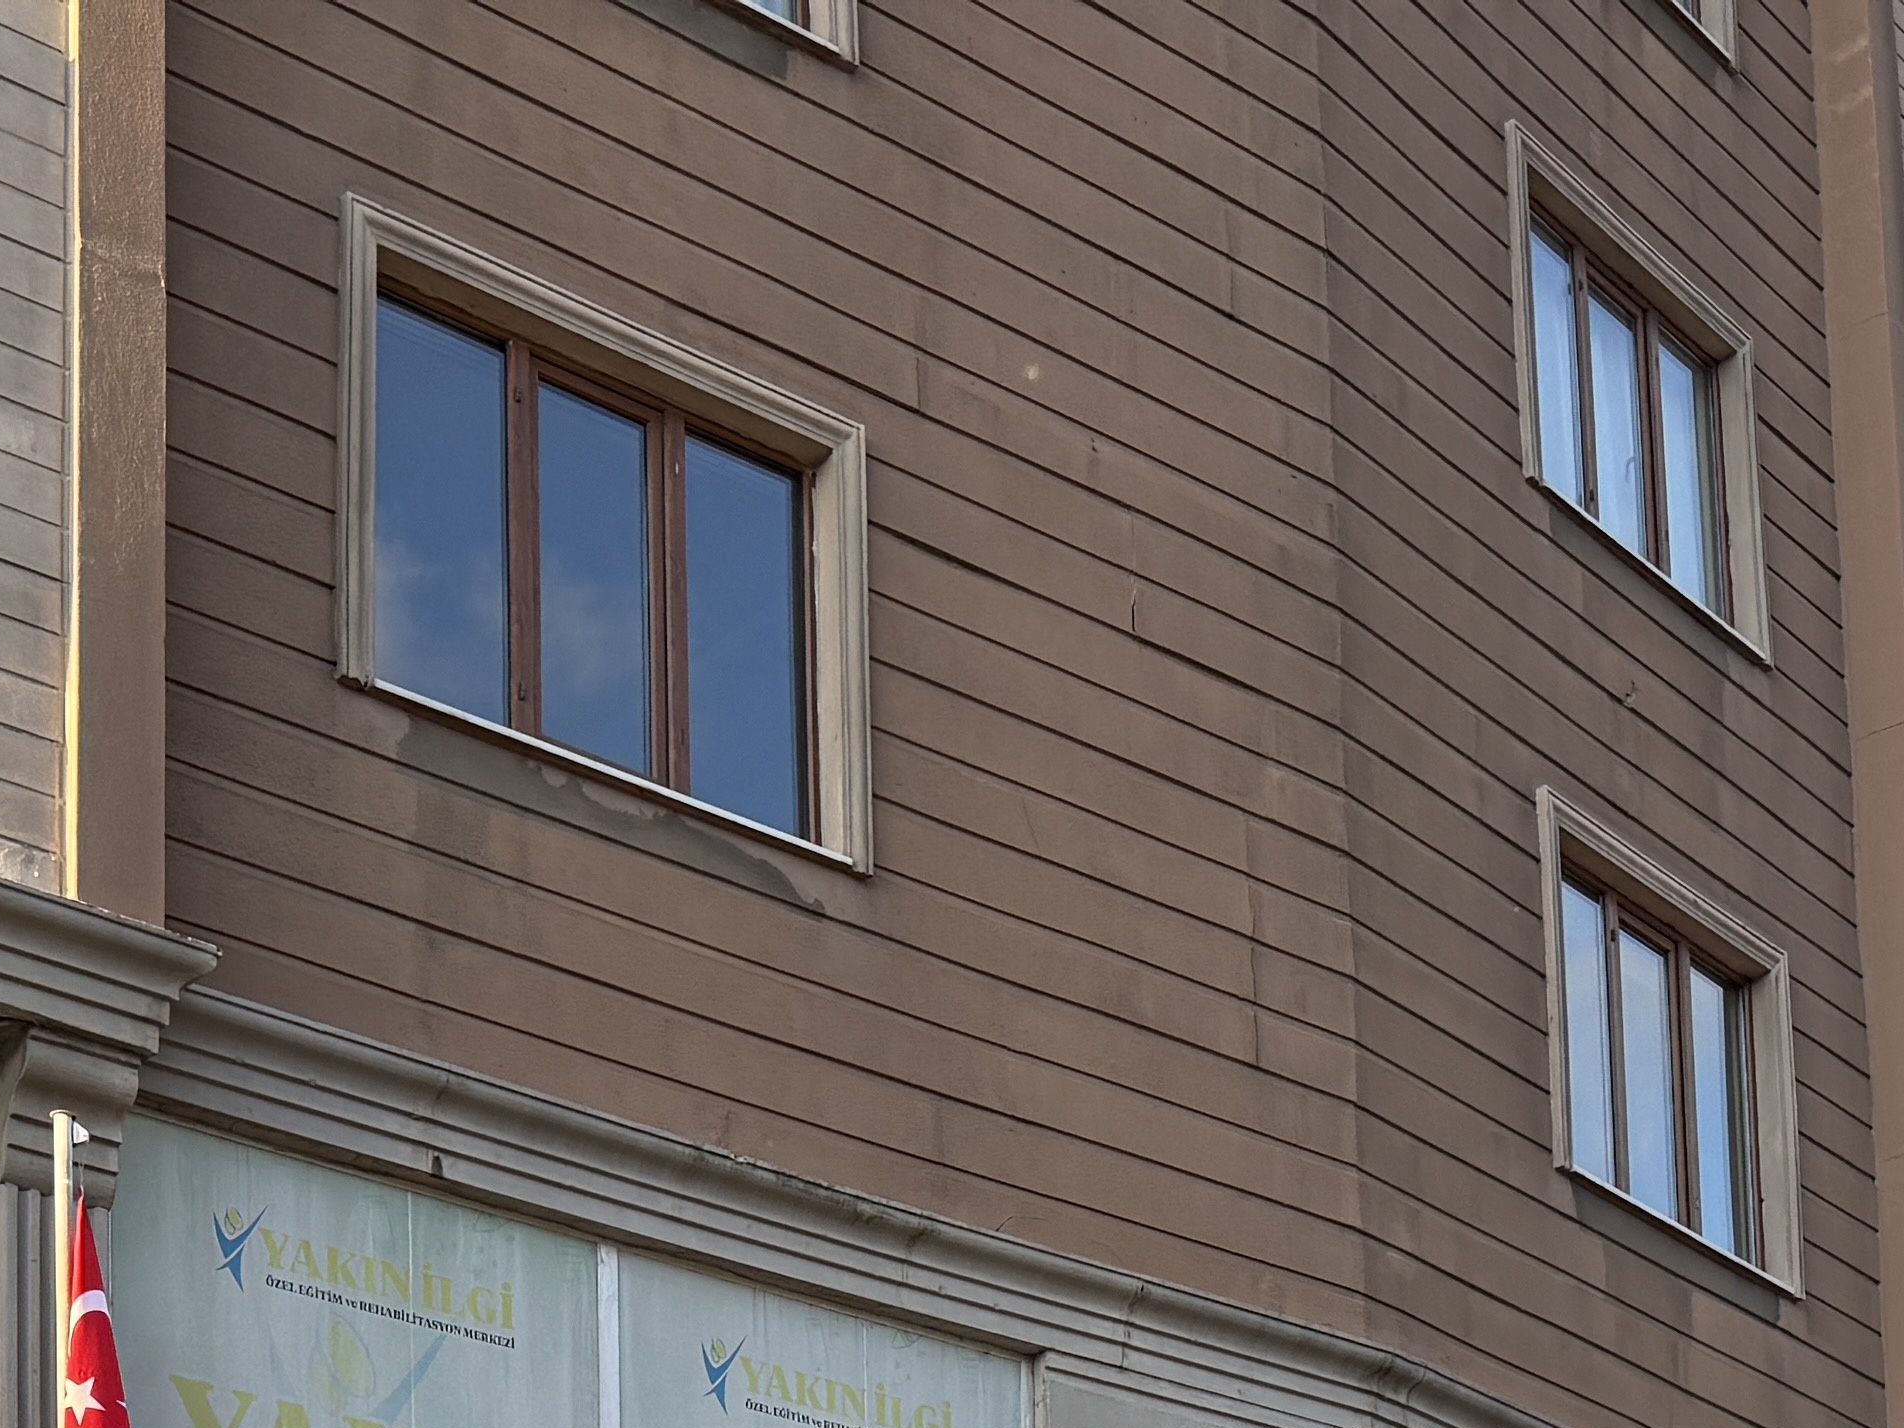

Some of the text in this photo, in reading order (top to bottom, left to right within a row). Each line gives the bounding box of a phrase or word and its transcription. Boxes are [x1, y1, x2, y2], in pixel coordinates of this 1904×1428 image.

[258, 1227, 515, 1330] YAKIN İLGİ
[266, 1274, 297, 1294] ÖZEL
[299, 1284, 343, 1305] EĞİTİM
[359, 1301, 461, 1335] REHABİLİTASYON
[462, 1327, 515, 1349] MERKEZİ
[739, 1356, 866, 1420] YAKIN
